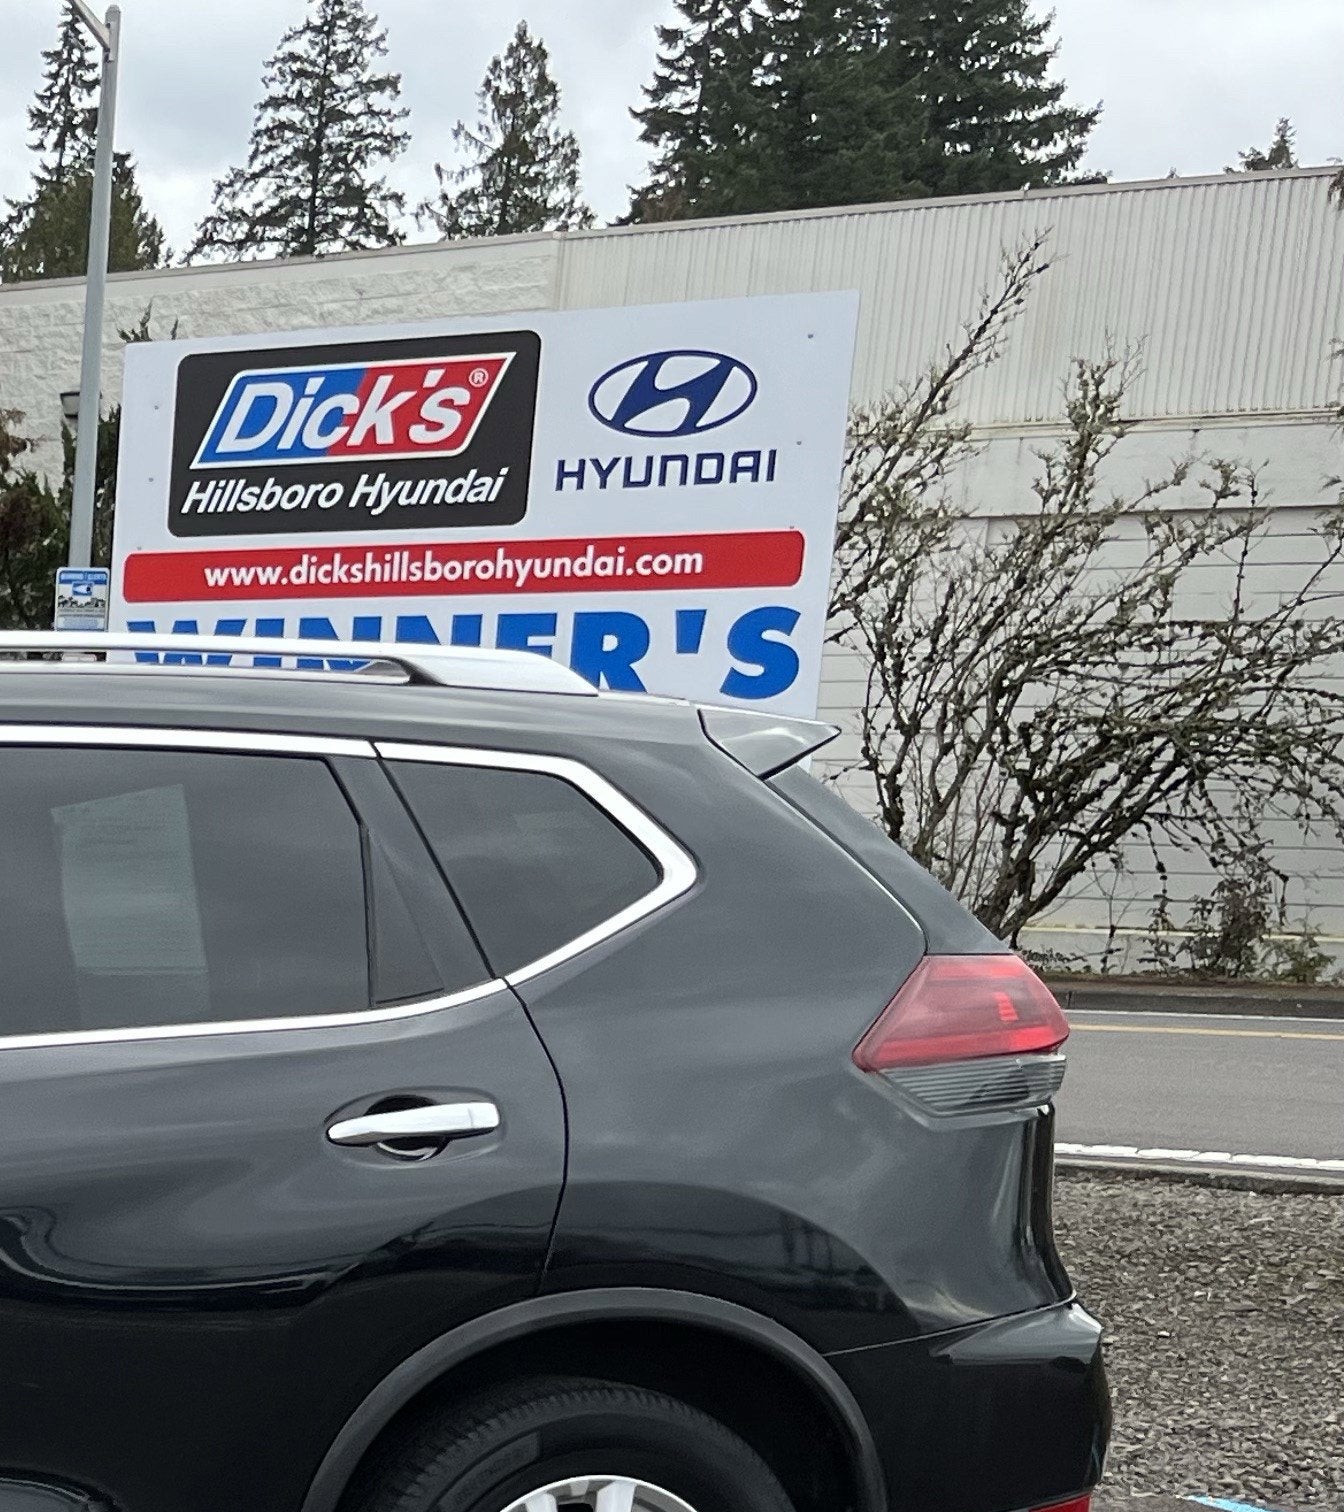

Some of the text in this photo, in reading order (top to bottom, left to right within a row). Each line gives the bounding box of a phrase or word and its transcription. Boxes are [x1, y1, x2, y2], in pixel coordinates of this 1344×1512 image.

[180, 466, 510, 515] Hillsboro Hyundai
[555, 448, 778, 491] HYUNDAI
[203, 545, 704, 588] www.dickshillsborohyundai.com
[126, 605, 802, 699] ER'S
